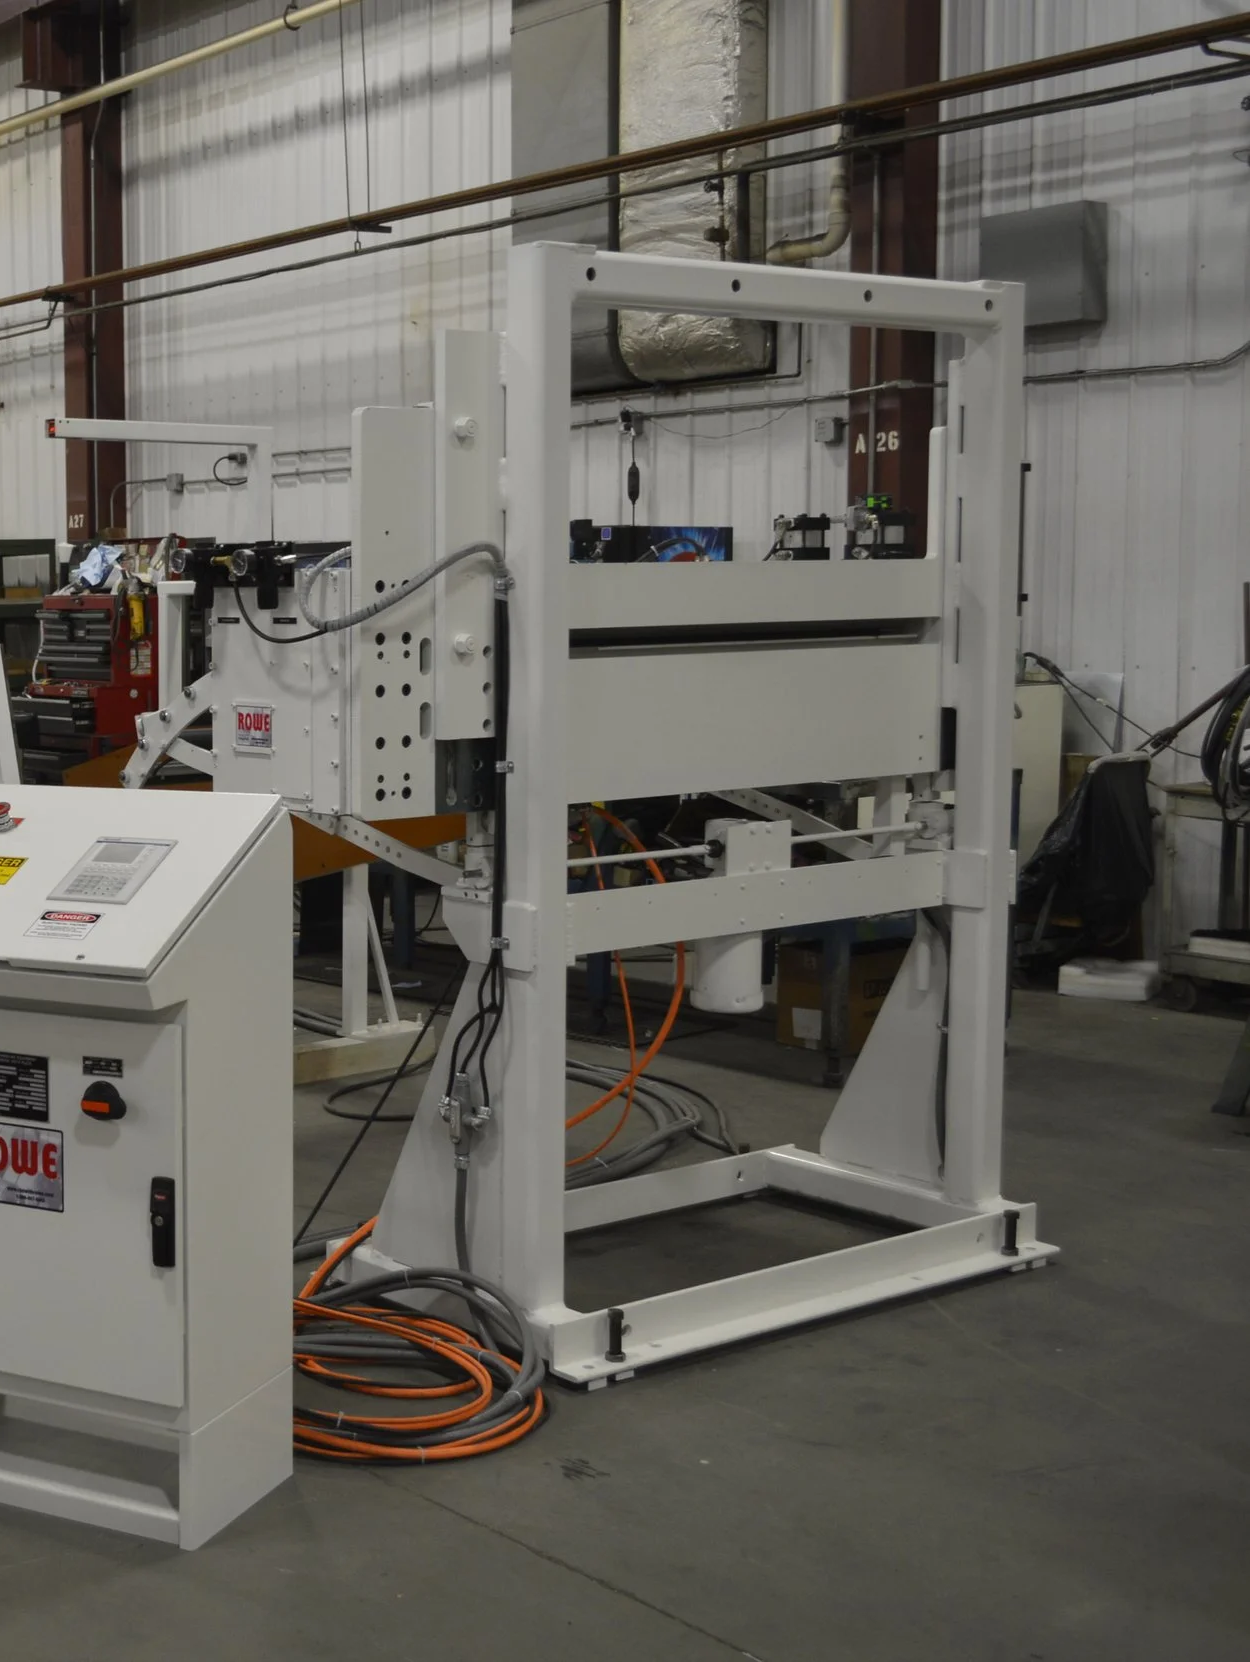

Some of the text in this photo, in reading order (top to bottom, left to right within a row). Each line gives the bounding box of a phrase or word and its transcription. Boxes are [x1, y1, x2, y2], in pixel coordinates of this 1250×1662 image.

[855, 430, 899, 454] A 26
[69, 514, 84, 528] A27
[238, 711, 270, 732] ROWE
[50, 913, 90, 921] DANGER
